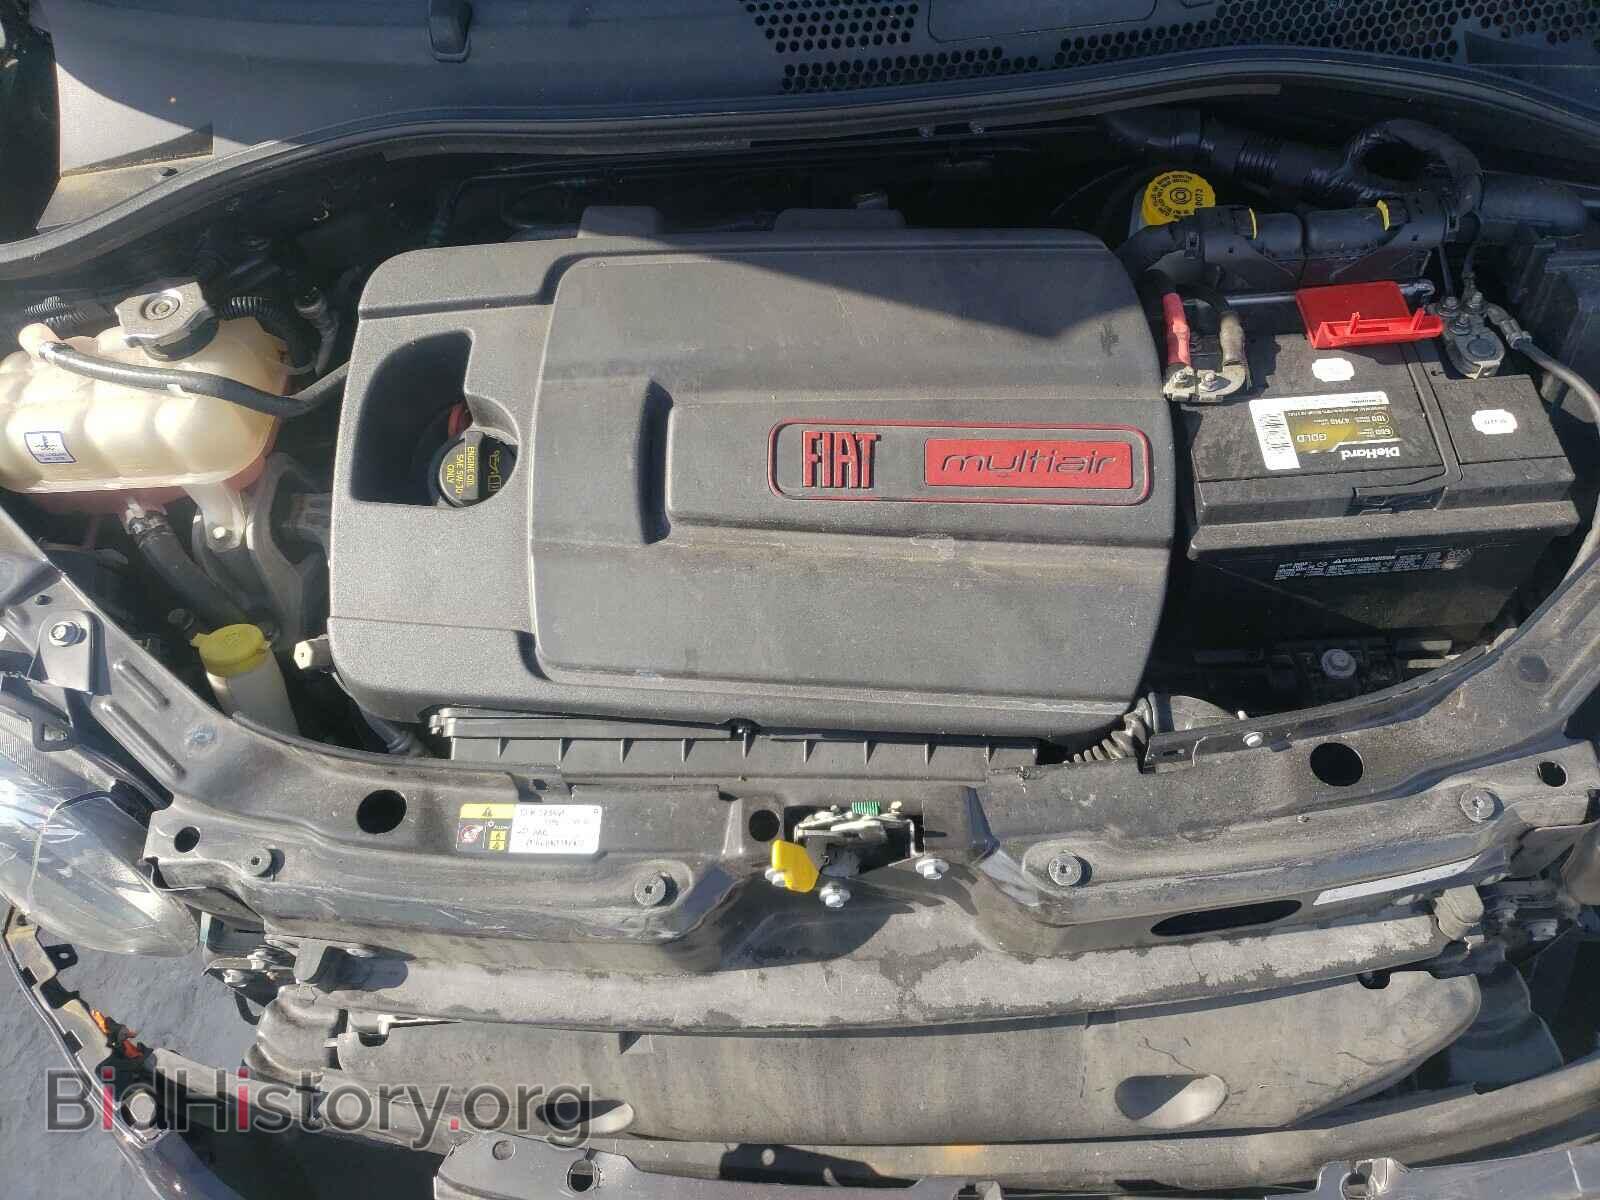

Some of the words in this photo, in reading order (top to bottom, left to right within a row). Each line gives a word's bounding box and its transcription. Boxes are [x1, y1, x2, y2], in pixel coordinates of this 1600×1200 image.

[1296, 433, 1328, 443] GOLD
[456, 454, 464, 469] SAE
[467, 446, 475, 473] ENGINE
[802, 430, 881, 489] FIAT
[942, 448, 1118, 478] multiair
[1341, 446, 1401, 461] DieHard
[446, 464, 455, 485] ONLY
[455, 470, 464, 494] 5W-30
[466, 474, 475, 488] OIL
